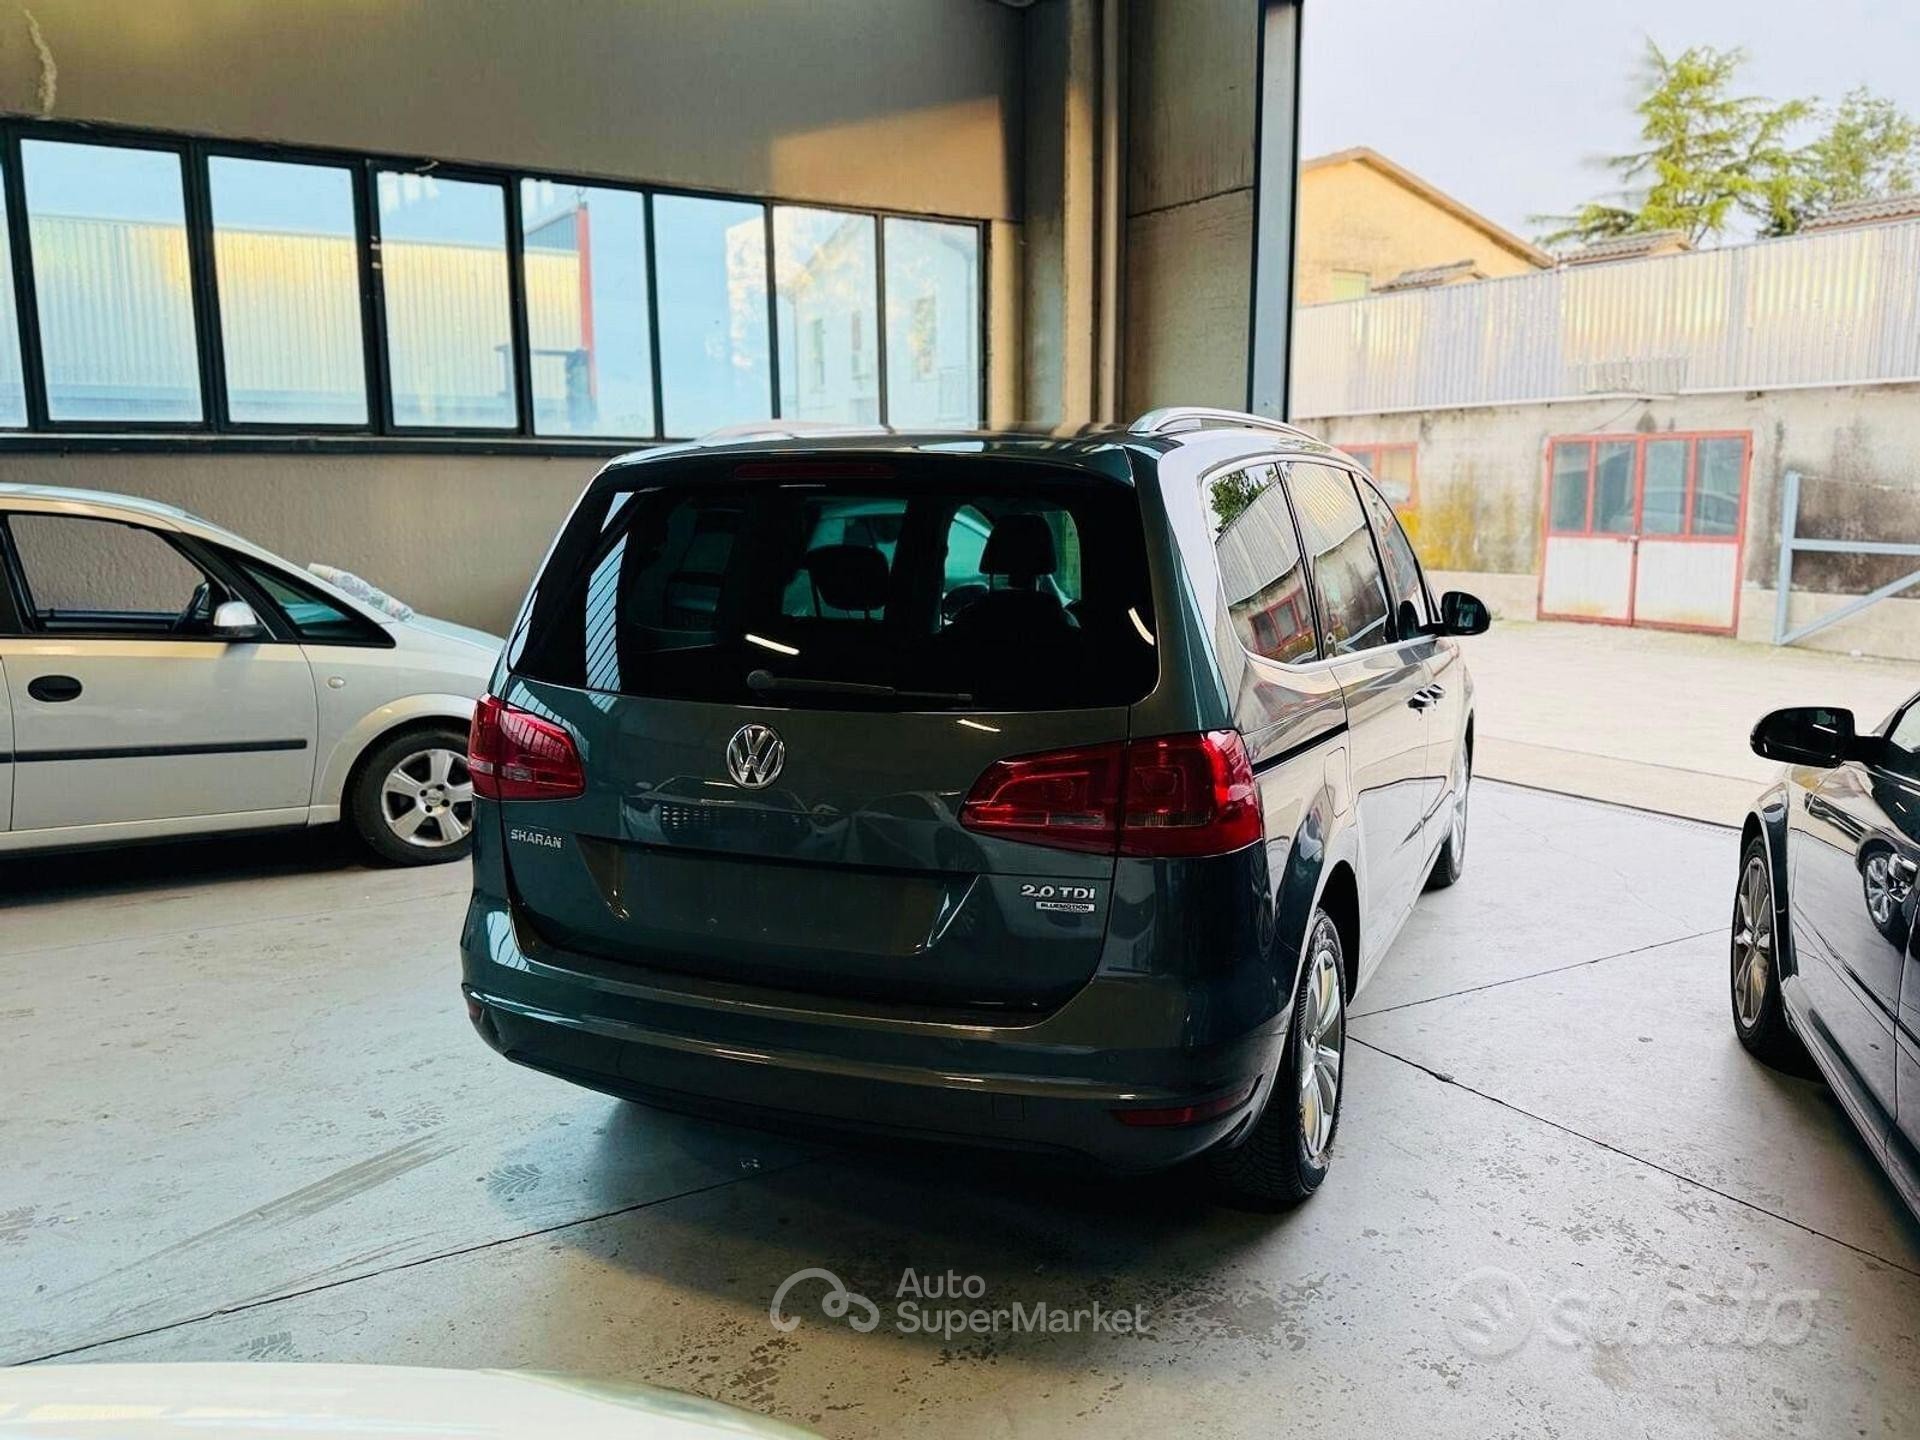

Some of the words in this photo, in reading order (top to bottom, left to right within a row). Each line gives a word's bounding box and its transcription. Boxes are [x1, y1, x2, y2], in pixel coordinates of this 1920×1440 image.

[511, 829, 562, 848] SHARAN
[1021, 884, 1055, 898] 2.0
[1059, 887, 1095, 899] TDI
